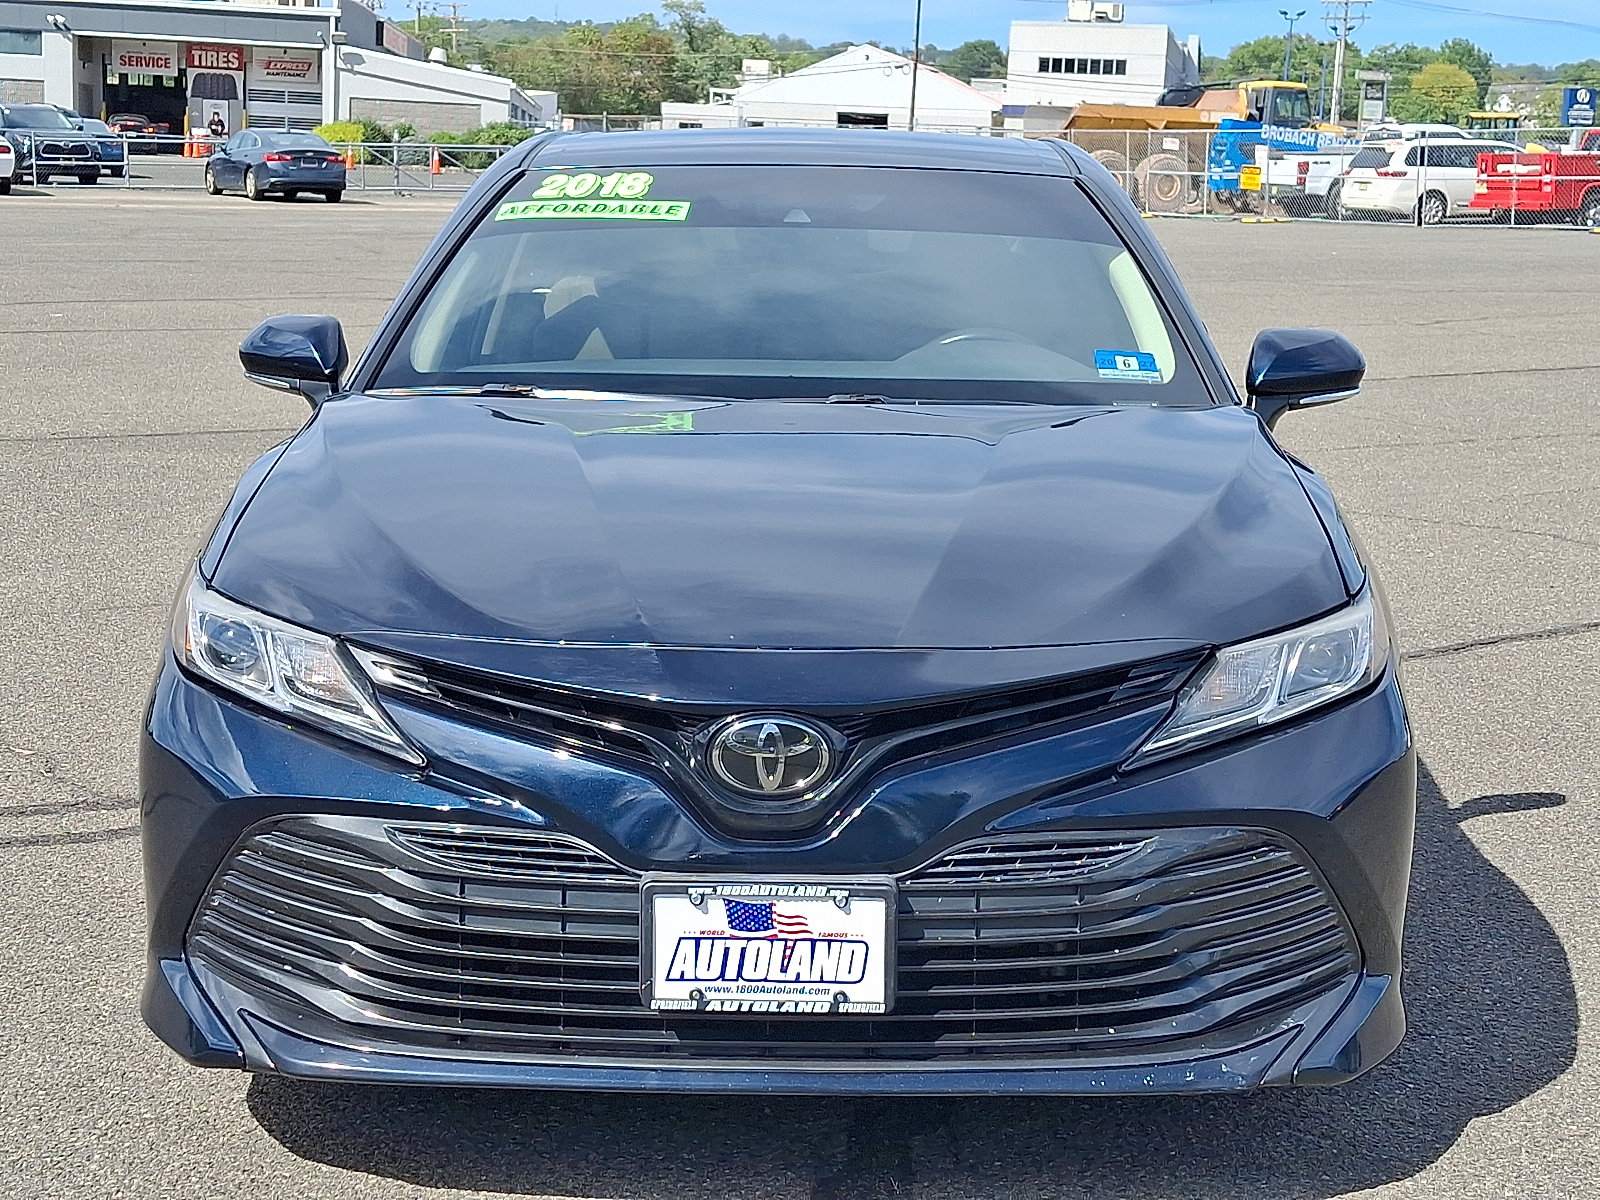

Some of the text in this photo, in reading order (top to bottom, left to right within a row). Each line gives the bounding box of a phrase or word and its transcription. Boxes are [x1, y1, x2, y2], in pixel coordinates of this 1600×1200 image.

[119, 54, 171, 69] SERVICE
[191, 50, 239, 69] TIRES
[269, 61, 310, 71] EXPRESS
[265, 71, 308, 79] MAINTENANCE
[532, 172, 654, 199] 2018
[501, 203, 685, 217] AFFORDABLE
[1123, 358, 1131, 369] 6
[665, 936, 869, 984] AUTOLAND
[704, 984, 831, 996] www.1800Autoland.com
[704, 1000, 832, 1014] AUTOLAND
